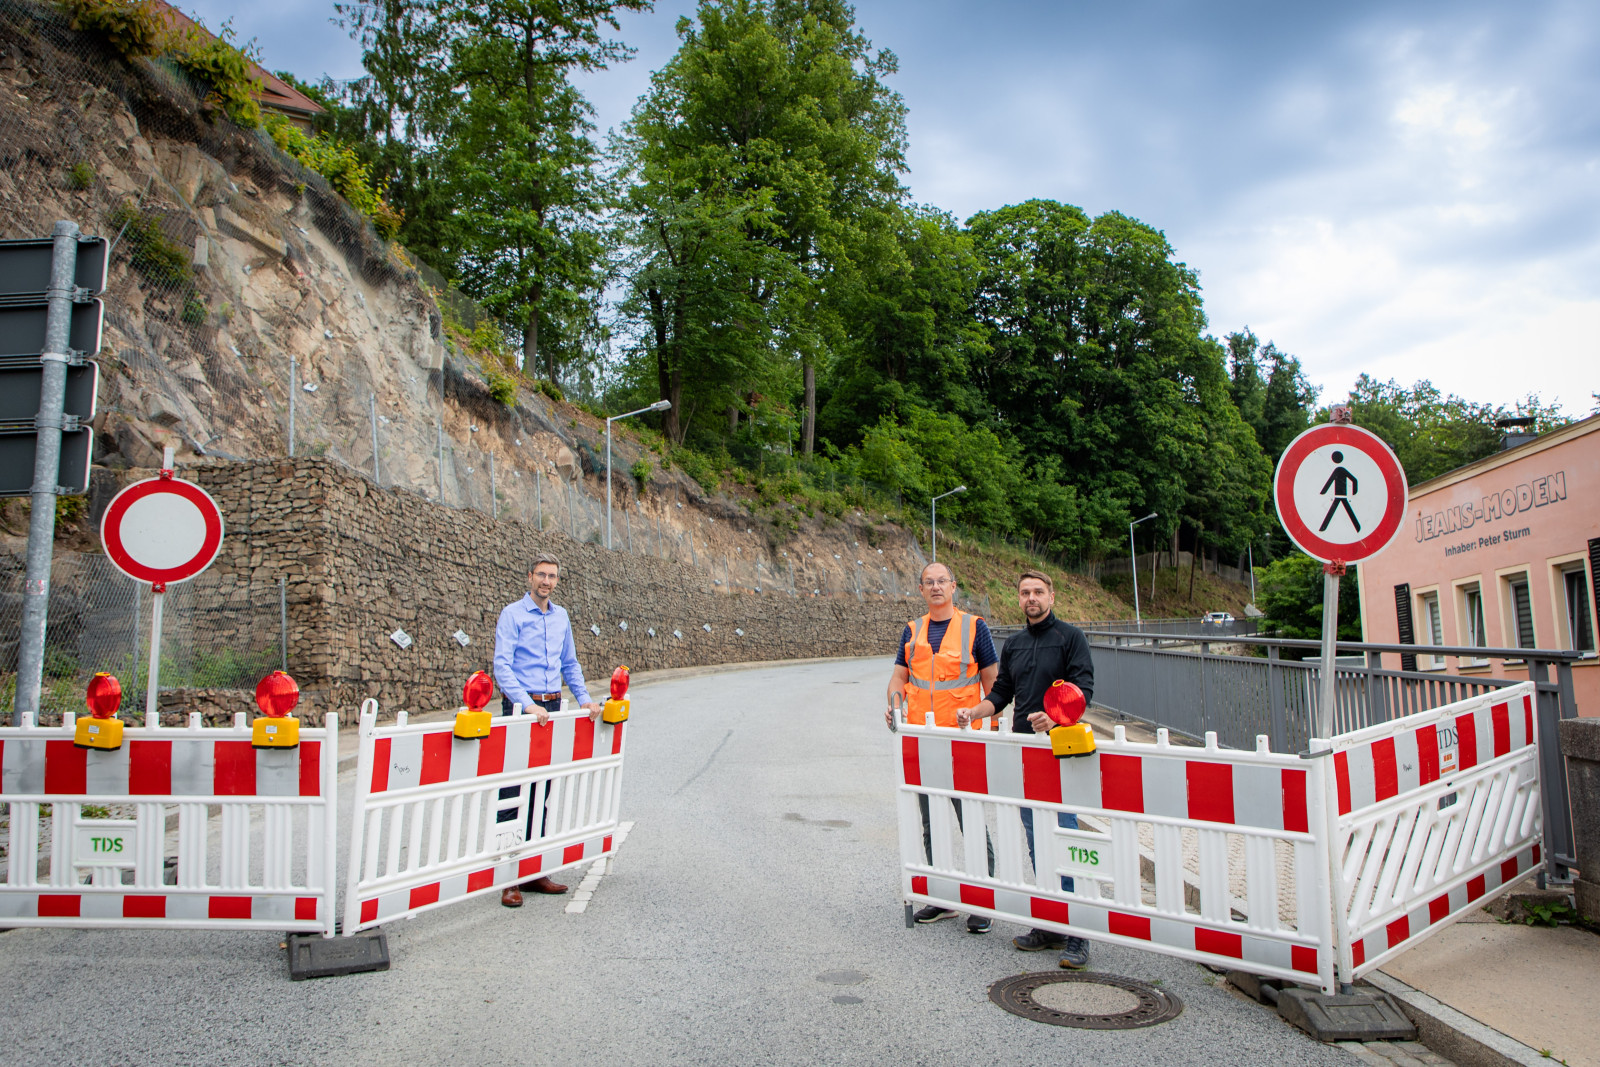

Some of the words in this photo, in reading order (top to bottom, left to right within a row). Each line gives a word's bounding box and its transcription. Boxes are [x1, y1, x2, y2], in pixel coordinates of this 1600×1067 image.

[1415, 471, 1567, 543] JEANS-MODEN
[1445, 541, 1477, 557] Inhaber:
[1478, 535, 1501, 548] Peter
[1503, 526, 1531, 542] Sturm
[1436, 726, 1459, 749] TDS
[90, 837, 123, 853] TDS
[496, 829, 523, 851] TDS
[1067, 845, 1099, 866] TDS
